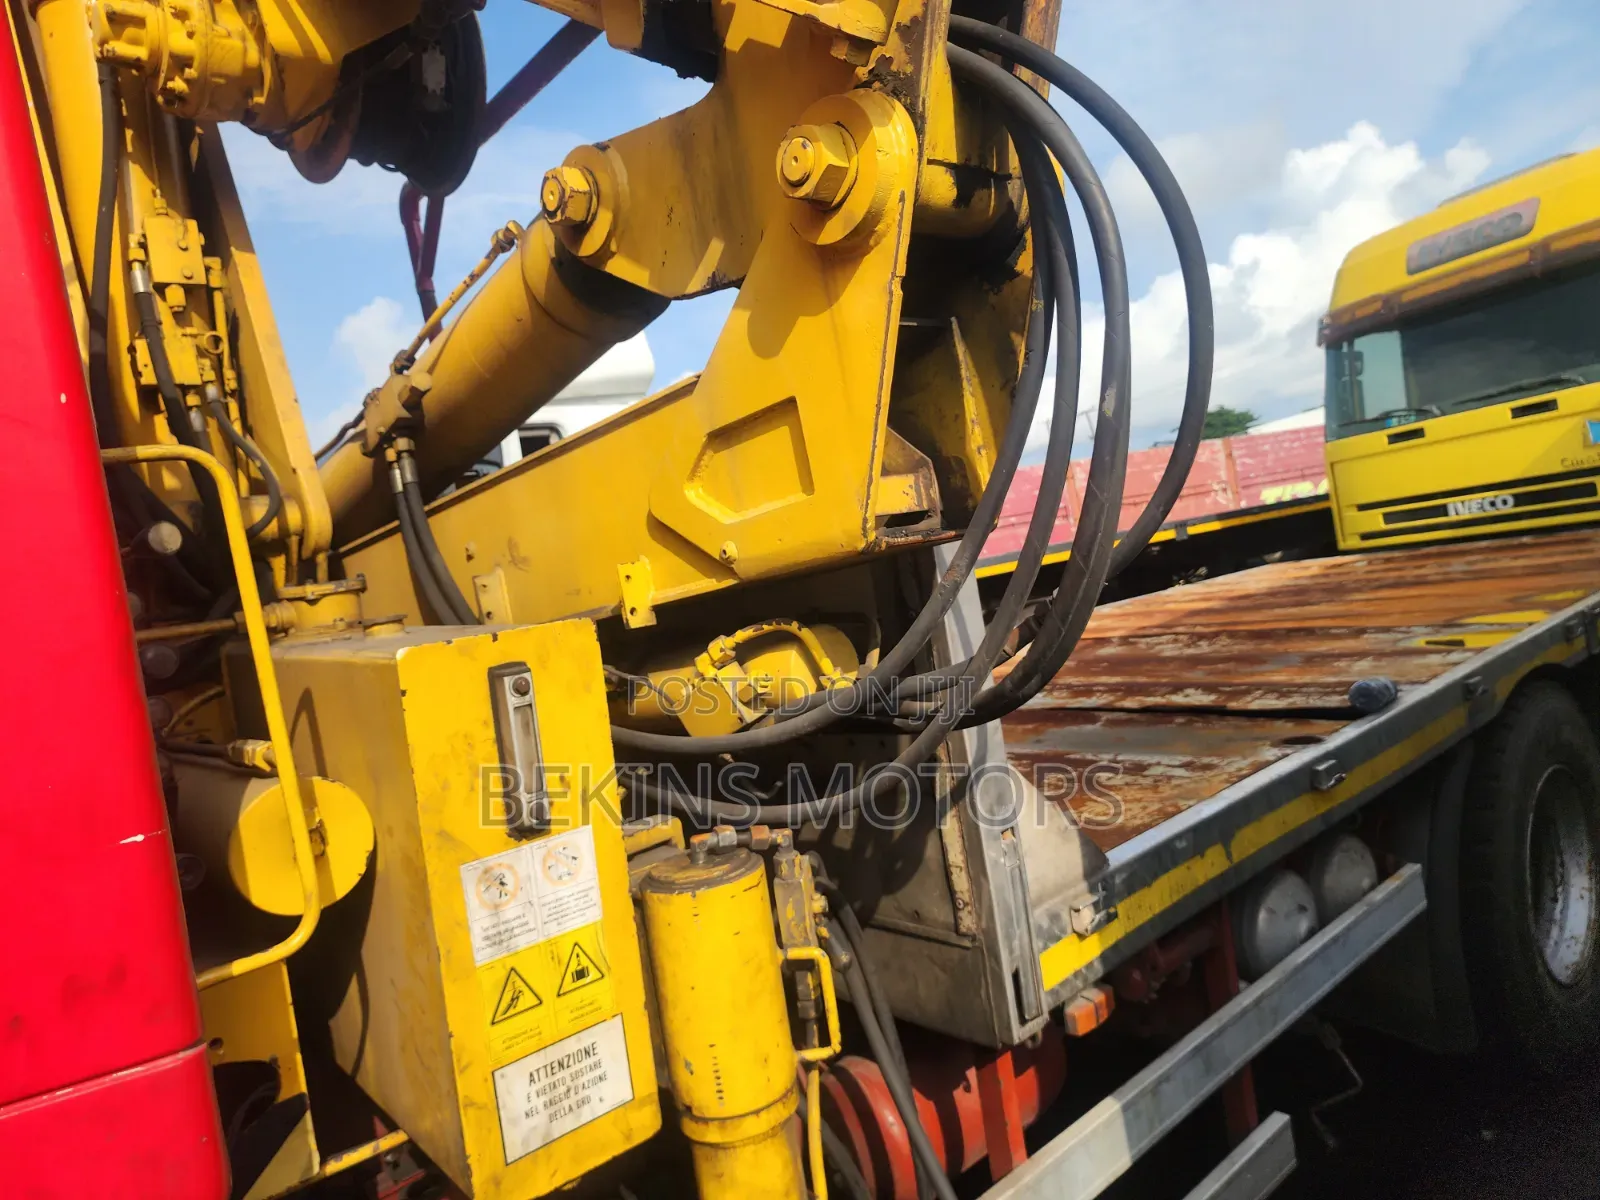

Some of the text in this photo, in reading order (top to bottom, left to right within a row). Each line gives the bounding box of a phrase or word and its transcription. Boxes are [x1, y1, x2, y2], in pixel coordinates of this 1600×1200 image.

[1446, 494, 1515, 516] IVECO
[529, 1041, 598, 1086] ATTENZIONE
[535, 1076, 567, 1099] VIETATO
[570, 1058, 603, 1082] SOSTARE
[524, 1107, 540, 1120] NEL
[543, 1089, 572, 1112] RAGGIO
[548, 1101, 574, 1124] DELLA
[576, 1095, 592, 1110] GRU
